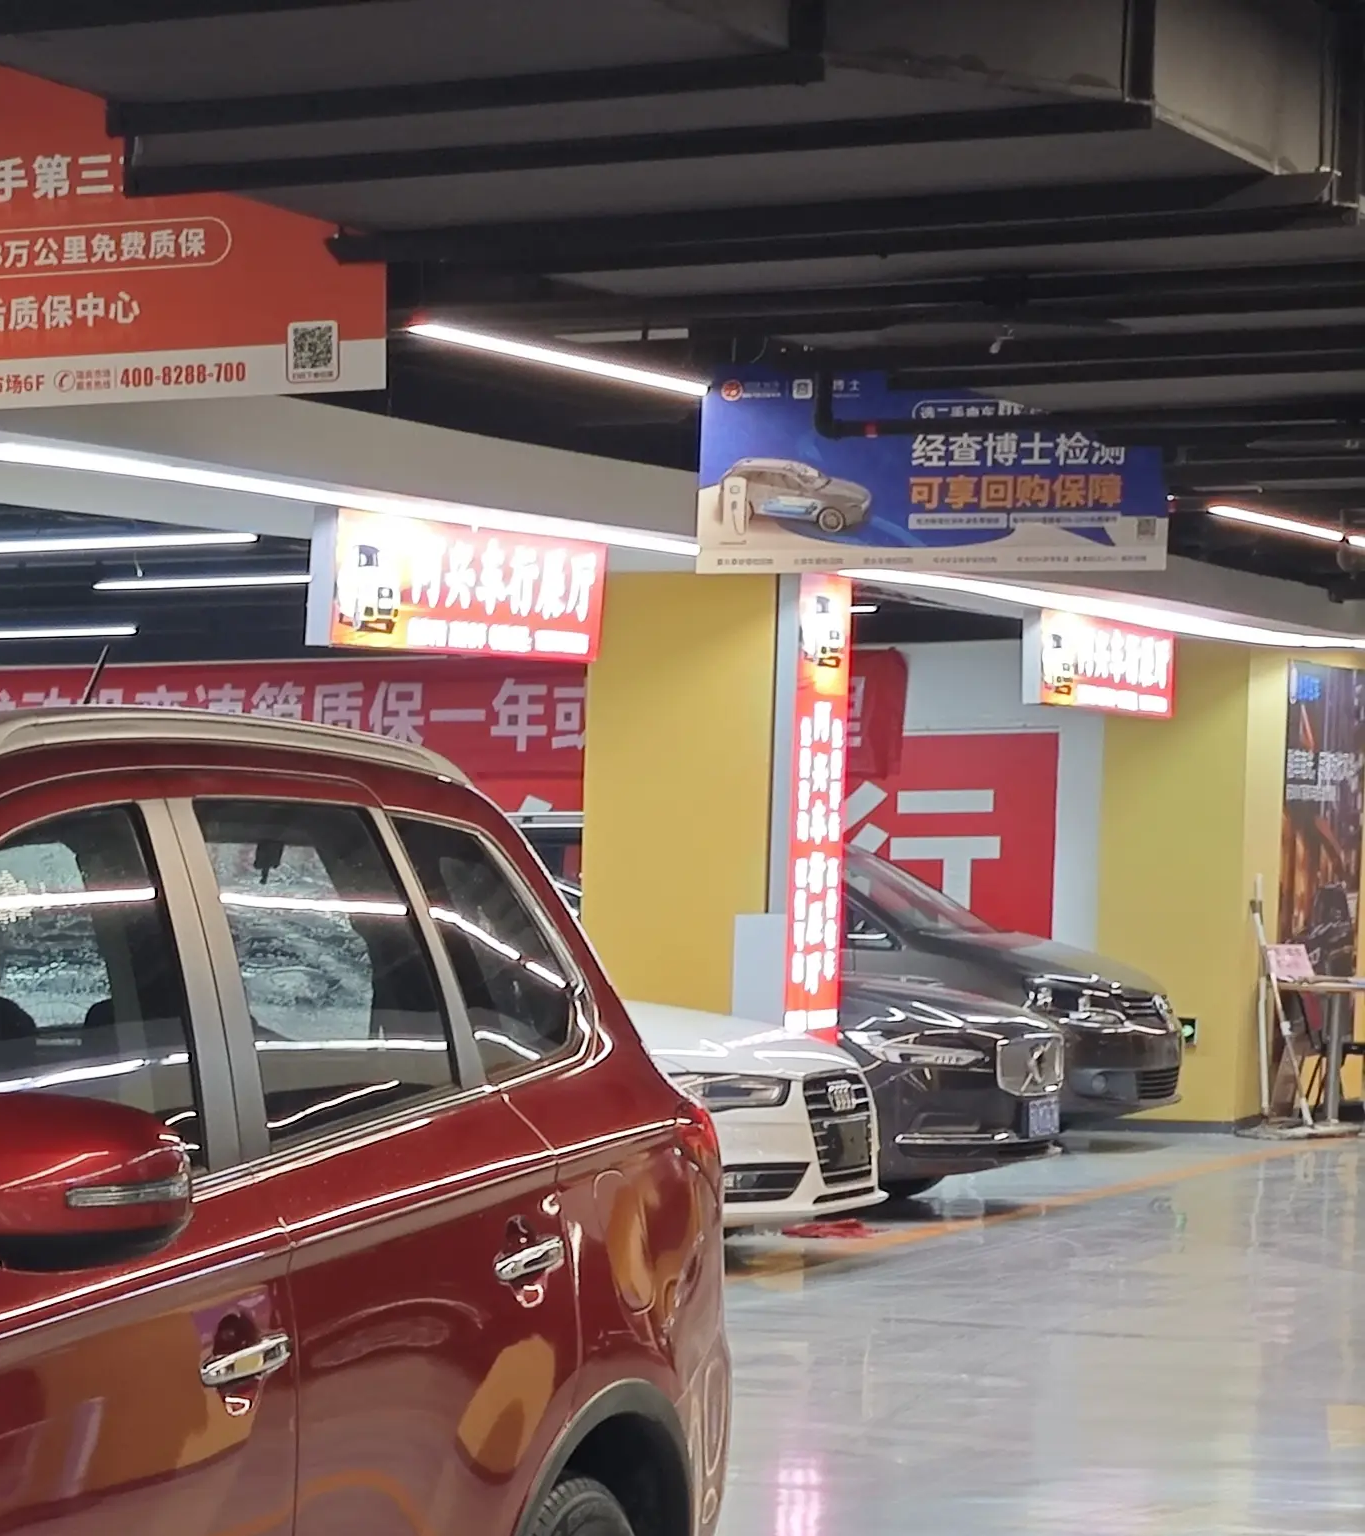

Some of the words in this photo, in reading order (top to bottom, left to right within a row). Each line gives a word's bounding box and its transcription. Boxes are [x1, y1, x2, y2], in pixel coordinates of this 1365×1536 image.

[120, 362, 246, 389] 400-8288-700
[911, 432, 1126, 467] 经查博士检测
[909, 474, 1123, 509] 可享回购保障
